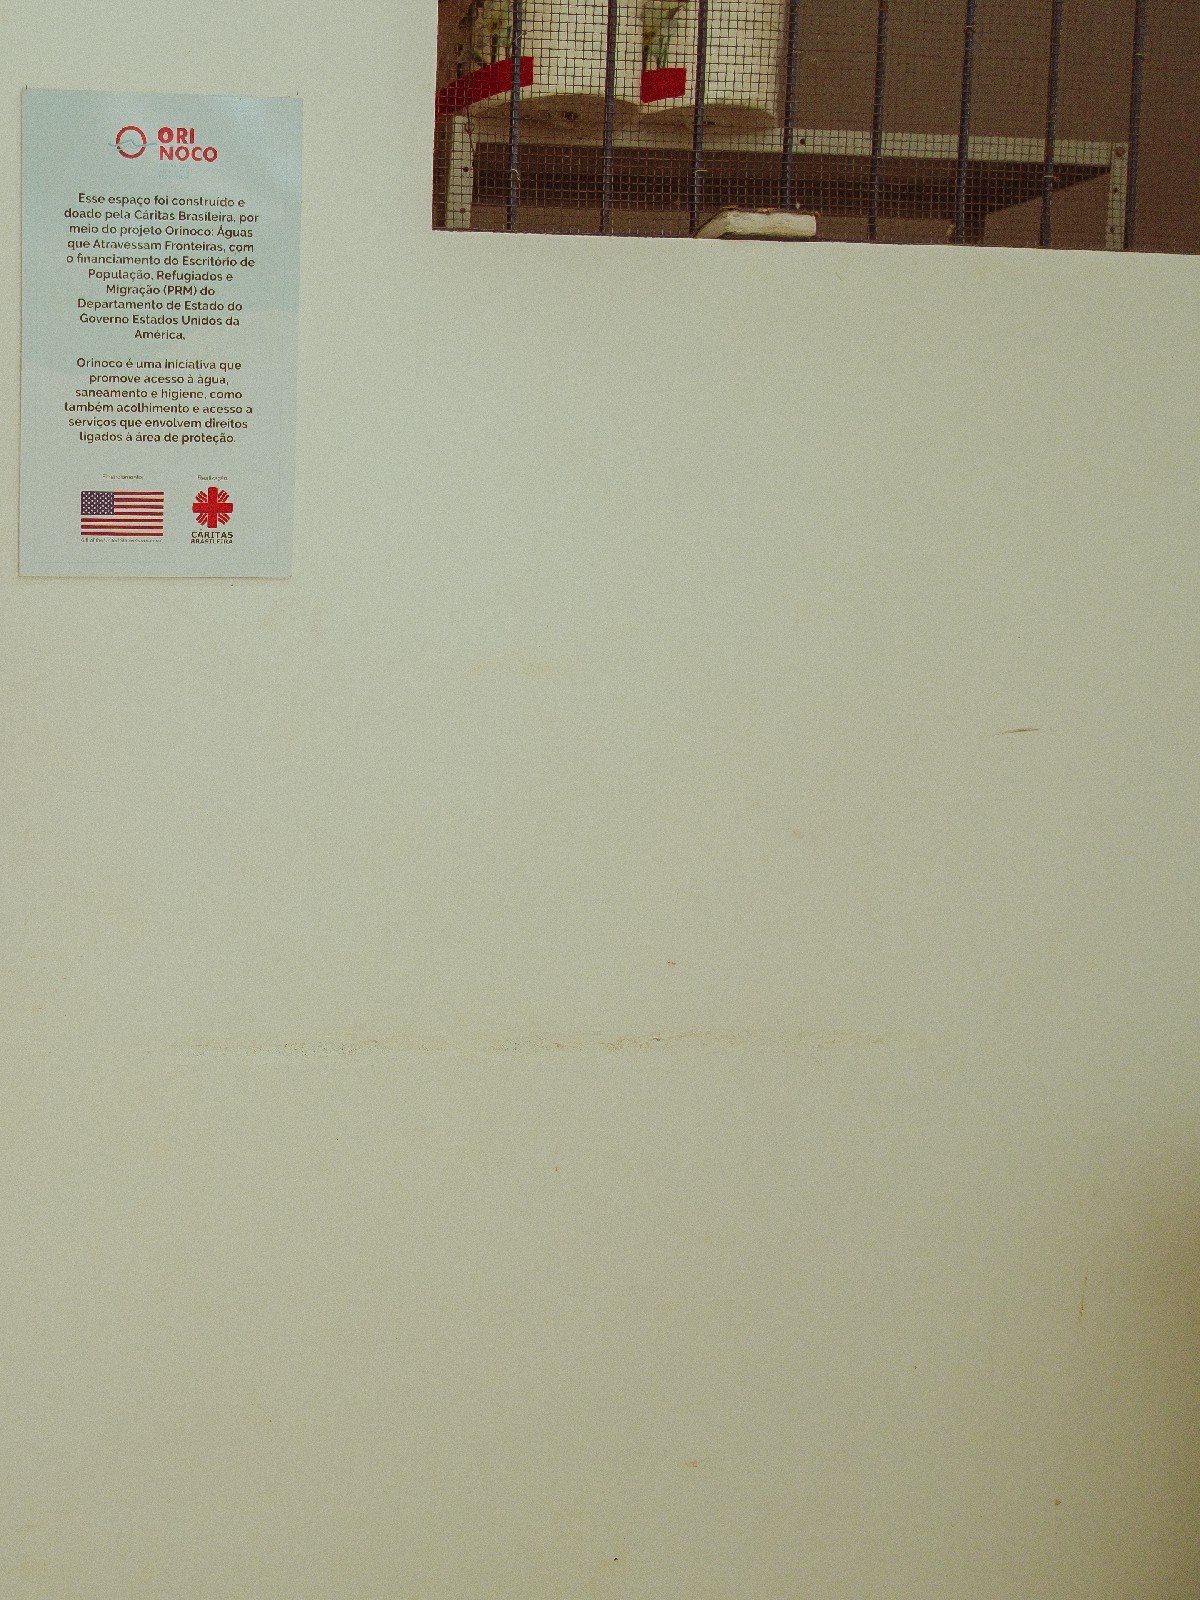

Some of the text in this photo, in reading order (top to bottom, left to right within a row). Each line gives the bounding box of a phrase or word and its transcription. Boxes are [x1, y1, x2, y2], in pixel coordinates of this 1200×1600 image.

[158, 127, 194, 144] ORI
[160, 146, 218, 162] NOCO
[79, 193, 245, 207] Esse espaço foi construído e
[64, 208, 259, 224] doado pela Cáritas Brasileira, por
[69, 224, 253, 239] meio do projeto Orinoco: Águas
[68, 240, 254, 253] que Atravessam Fronteiras, com
[77, 253, 160, 265] financiamento
[164, 255, 179, 265] do
[183, 256, 237, 266] Escritório
[240, 257, 255, 267] de
[88, 269, 154, 282] População,
[157, 271, 222, 283] Refugiados
[107, 285, 215, 297] Migração (PRM) do
[78, 298, 242, 311] Departamento de Estado do
[80, 313, 240, 326] Governo Estados Unidos da
[134, 330, 186, 340] América.
[77, 358, 241, 372] Orinoco é uma iniciativa que
[90, 374, 140, 384] promove
[188, 374, 194, 383] à
[75, 388, 242, 400] saneamento e higiene, como
[64, 402, 113, 412] também
[117, 403, 189, 413] acolhimento
[193, 405, 199, 413] e
[246, 406, 253, 414] a
[69, 417, 248, 429] serviços que envolvem direitos
[80, 432, 235, 445] ligados à área de proteção.
[191, 529, 233, 538] CÁRITAS
